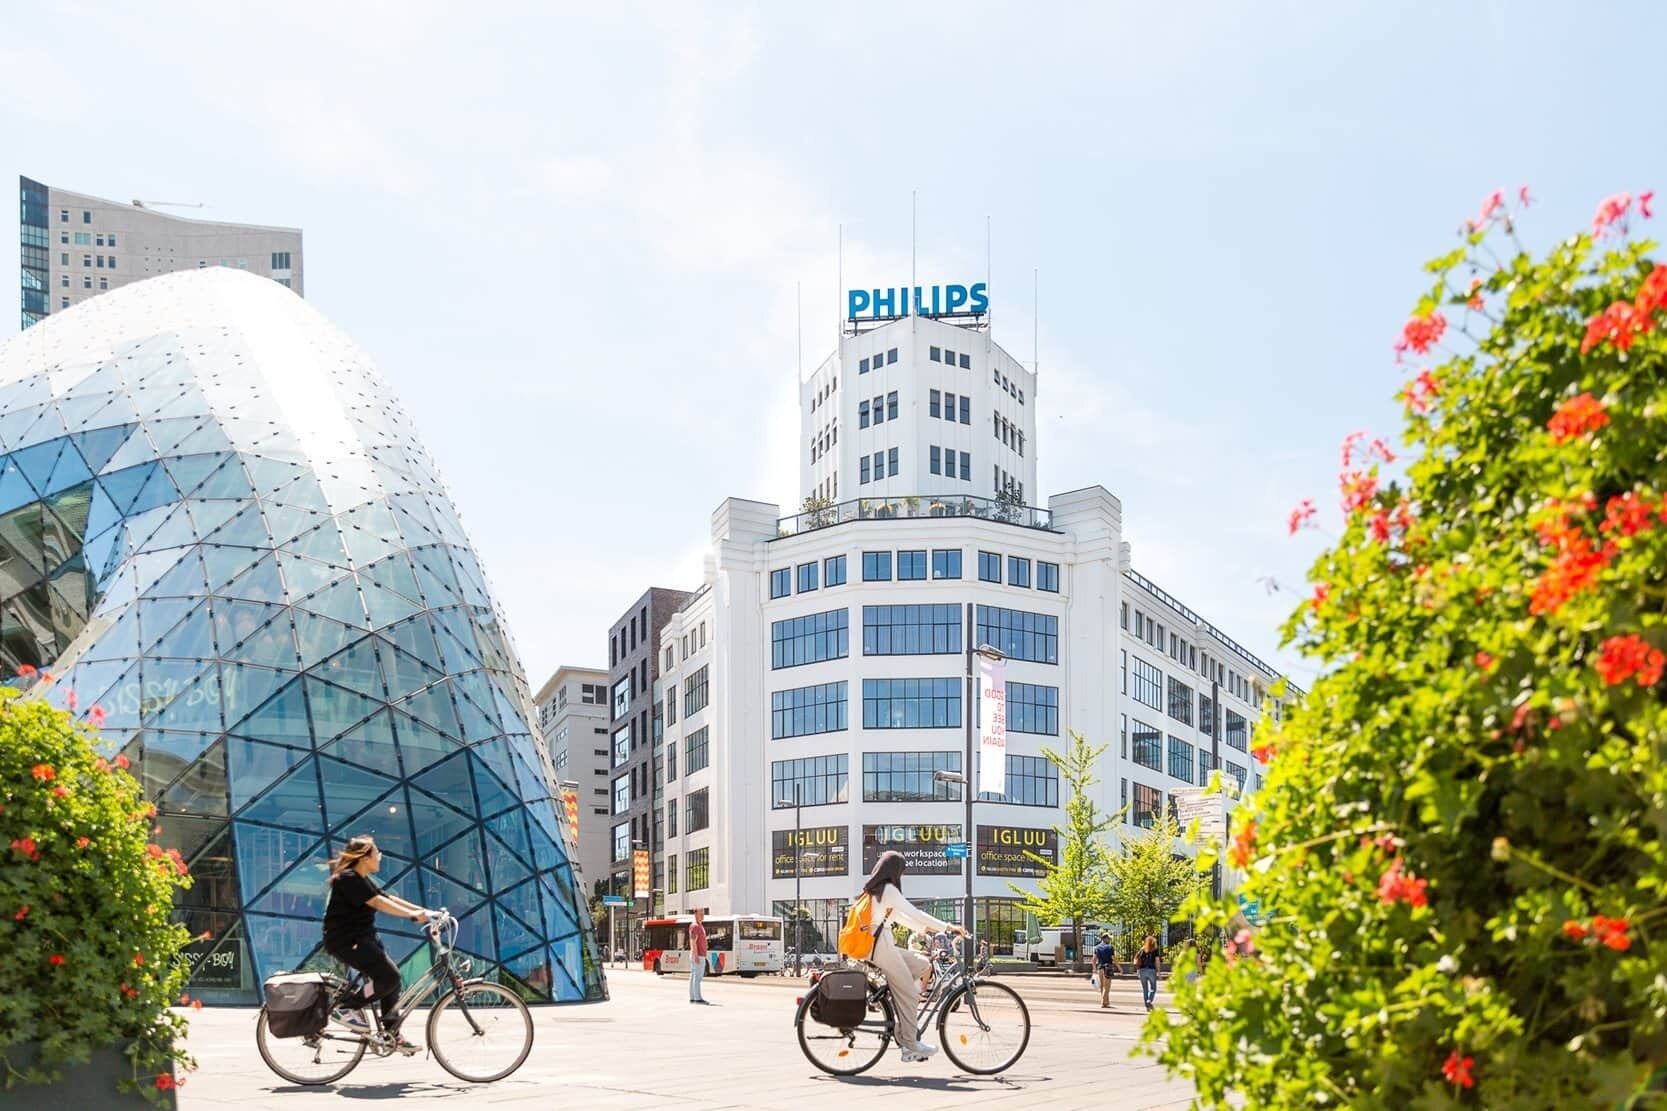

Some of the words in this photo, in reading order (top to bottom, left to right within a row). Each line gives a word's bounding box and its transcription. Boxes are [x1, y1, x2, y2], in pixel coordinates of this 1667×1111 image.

[848, 283, 989, 318] PHILIPS
[788, 829, 837, 847] IGLUU
[994, 829, 1046, 846] IGLUU
[915, 859, 948, 867] location
[981, 850, 1003, 861] office
[1004, 853, 1026, 863] space
